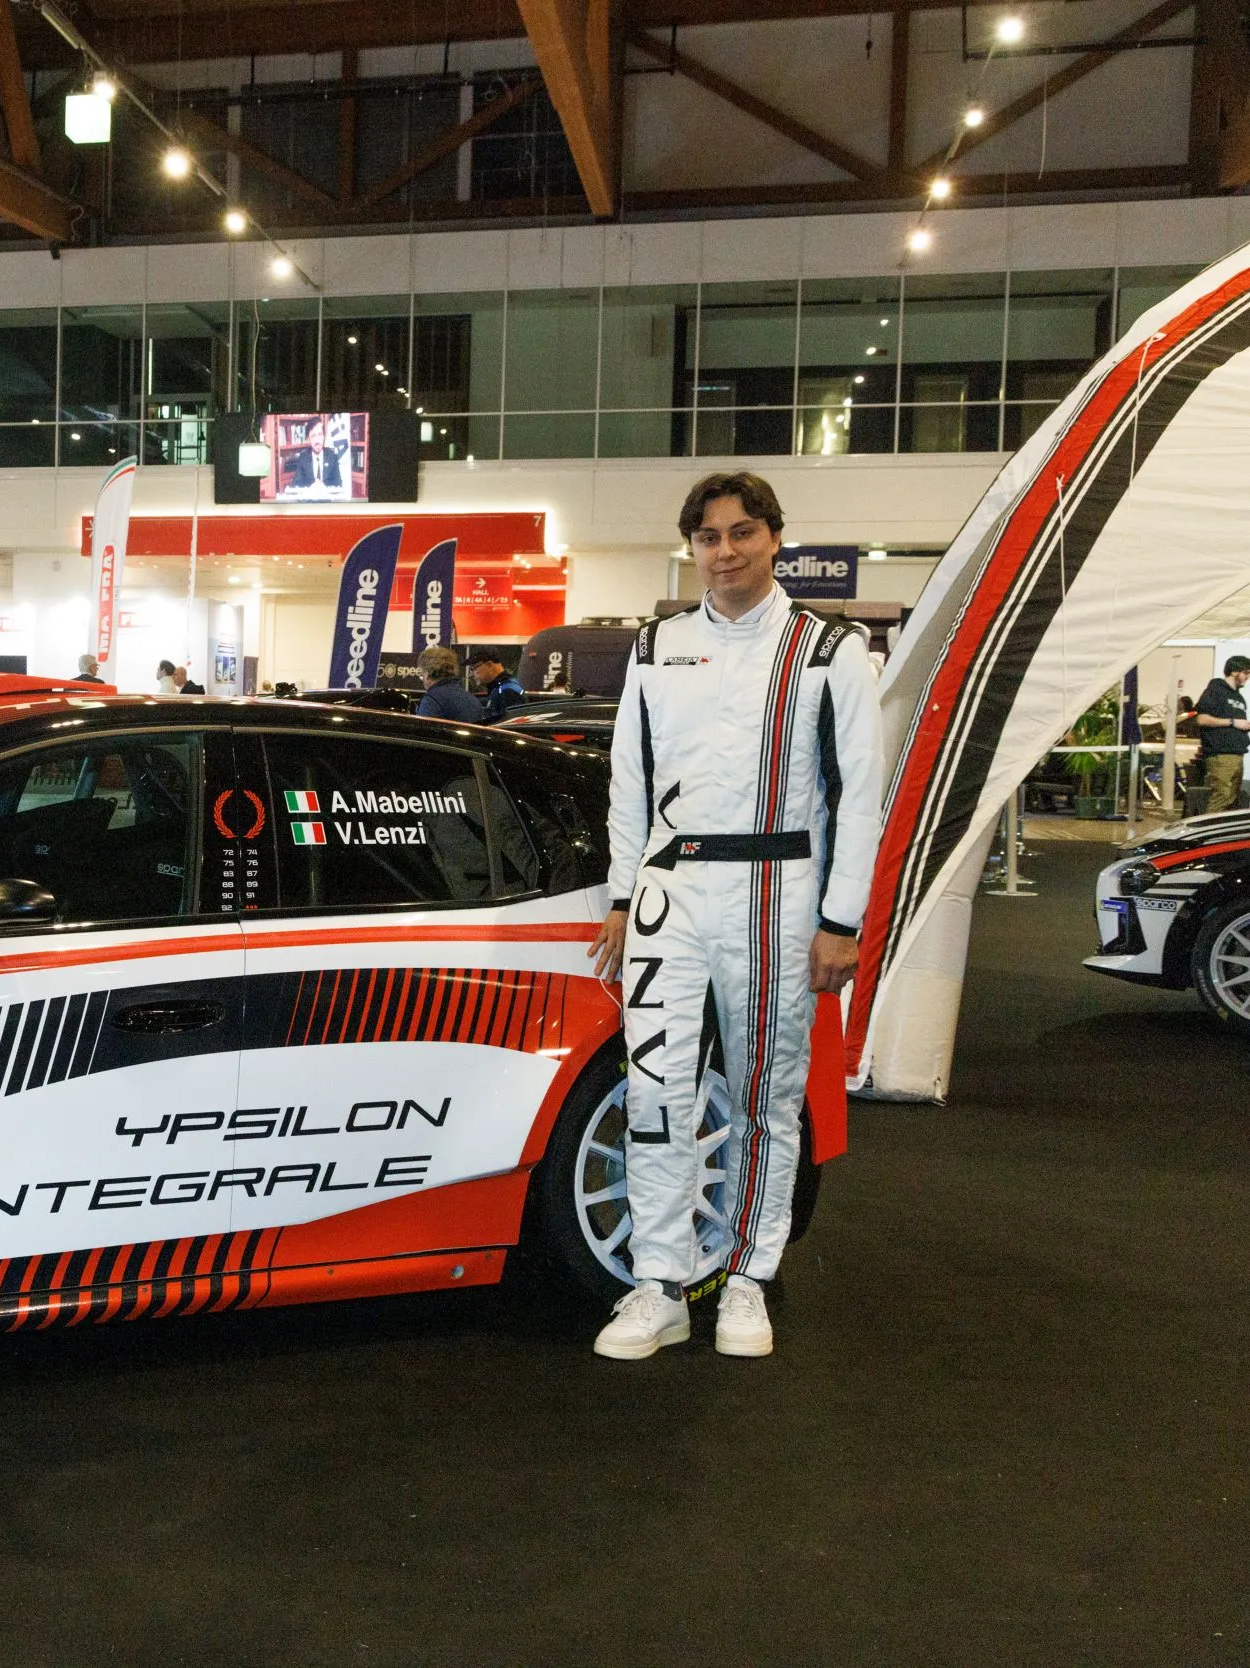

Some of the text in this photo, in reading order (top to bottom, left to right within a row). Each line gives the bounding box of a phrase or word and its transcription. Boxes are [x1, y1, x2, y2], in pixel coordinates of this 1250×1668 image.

[533, 515, 542, 527] 7
[774, 555, 850, 578] edline
[421, 580, 443, 650] dline
[344, 568, 379, 688] peedline
[819, 626, 846, 659] sparco
[397, 664, 424, 678] spee
[331, 790, 467, 814] A.Mabellini
[334, 821, 427, 845] V.Lenzi
[157, 863, 185, 874] spar
[115, 1096, 452, 1148] YPSILON
